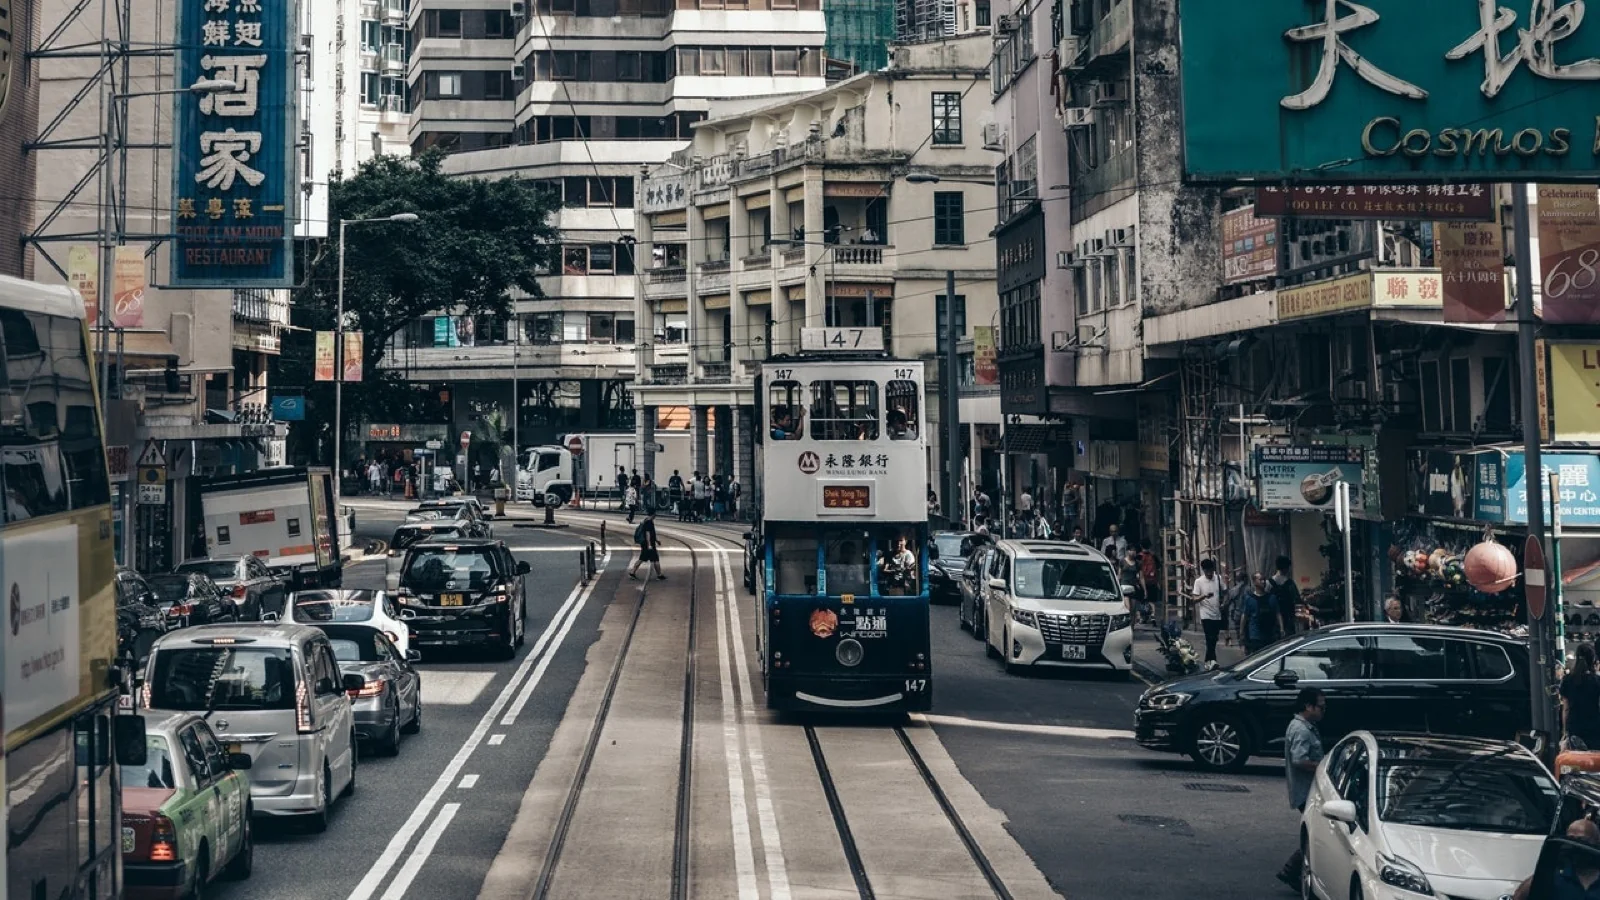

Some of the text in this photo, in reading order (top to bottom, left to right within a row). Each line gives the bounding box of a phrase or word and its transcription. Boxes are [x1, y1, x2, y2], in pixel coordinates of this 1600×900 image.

[195, 54, 268, 191] 酒家
[1361, 116, 1571, 157] Cosmos
[1539, 188, 1596, 201] Celebrating
[214, 225, 241, 242] LAM
[1463, 231, 1494, 246] 慶祝
[186, 248, 272, 265] RESTAURANT
[1544, 249, 1599, 299] 68
[1386, 276, 1439, 300] 聯發
[115, 289, 142, 315] 68
[823, 329, 863, 348] 147
[775, 369, 792, 380] 147
[894, 368, 913, 380] 147
[825, 453, 889, 469] 永隆銀行
[1263, 465, 1296, 473] EMTRIX
[143, 494, 160, 502] 全日
[840, 616, 887, 631] 一點通
[905, 679, 926, 692] 147
